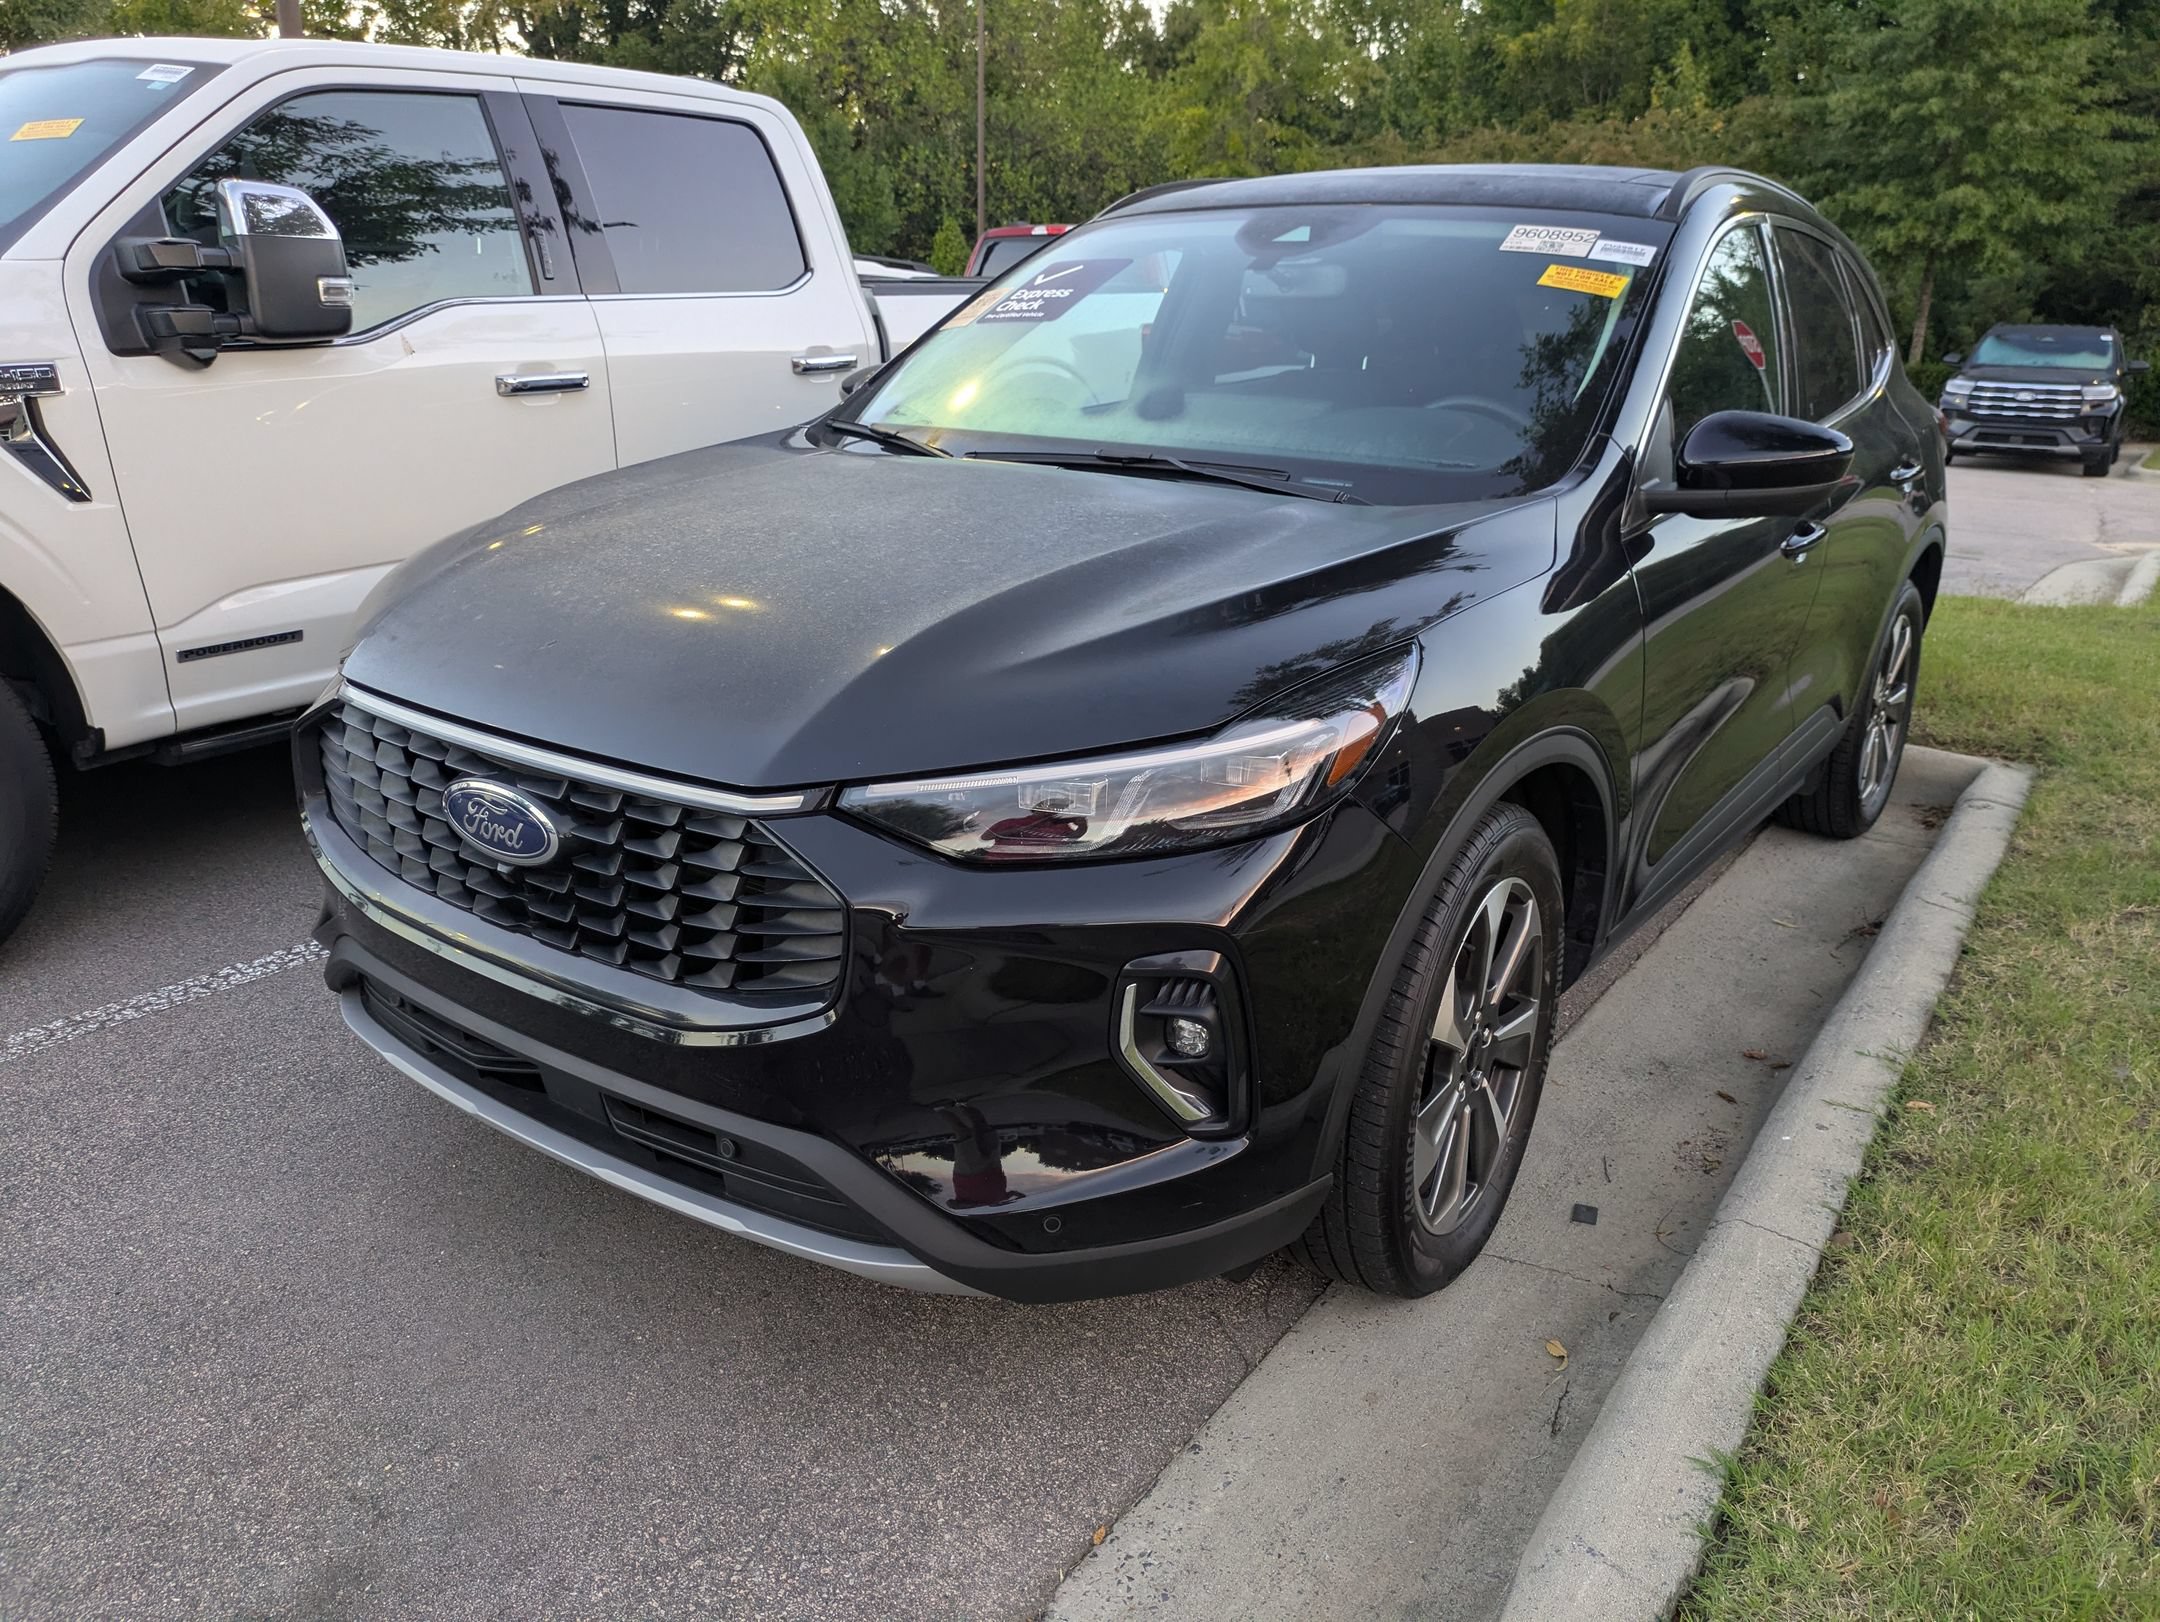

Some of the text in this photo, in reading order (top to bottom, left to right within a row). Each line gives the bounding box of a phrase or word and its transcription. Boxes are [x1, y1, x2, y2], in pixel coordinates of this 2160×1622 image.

[1513, 228, 1598, 243] 9608952
[1010, 289, 1074, 300] Express
[996, 299, 1045, 311] Check
[463, 797, 523, 850] Ford
